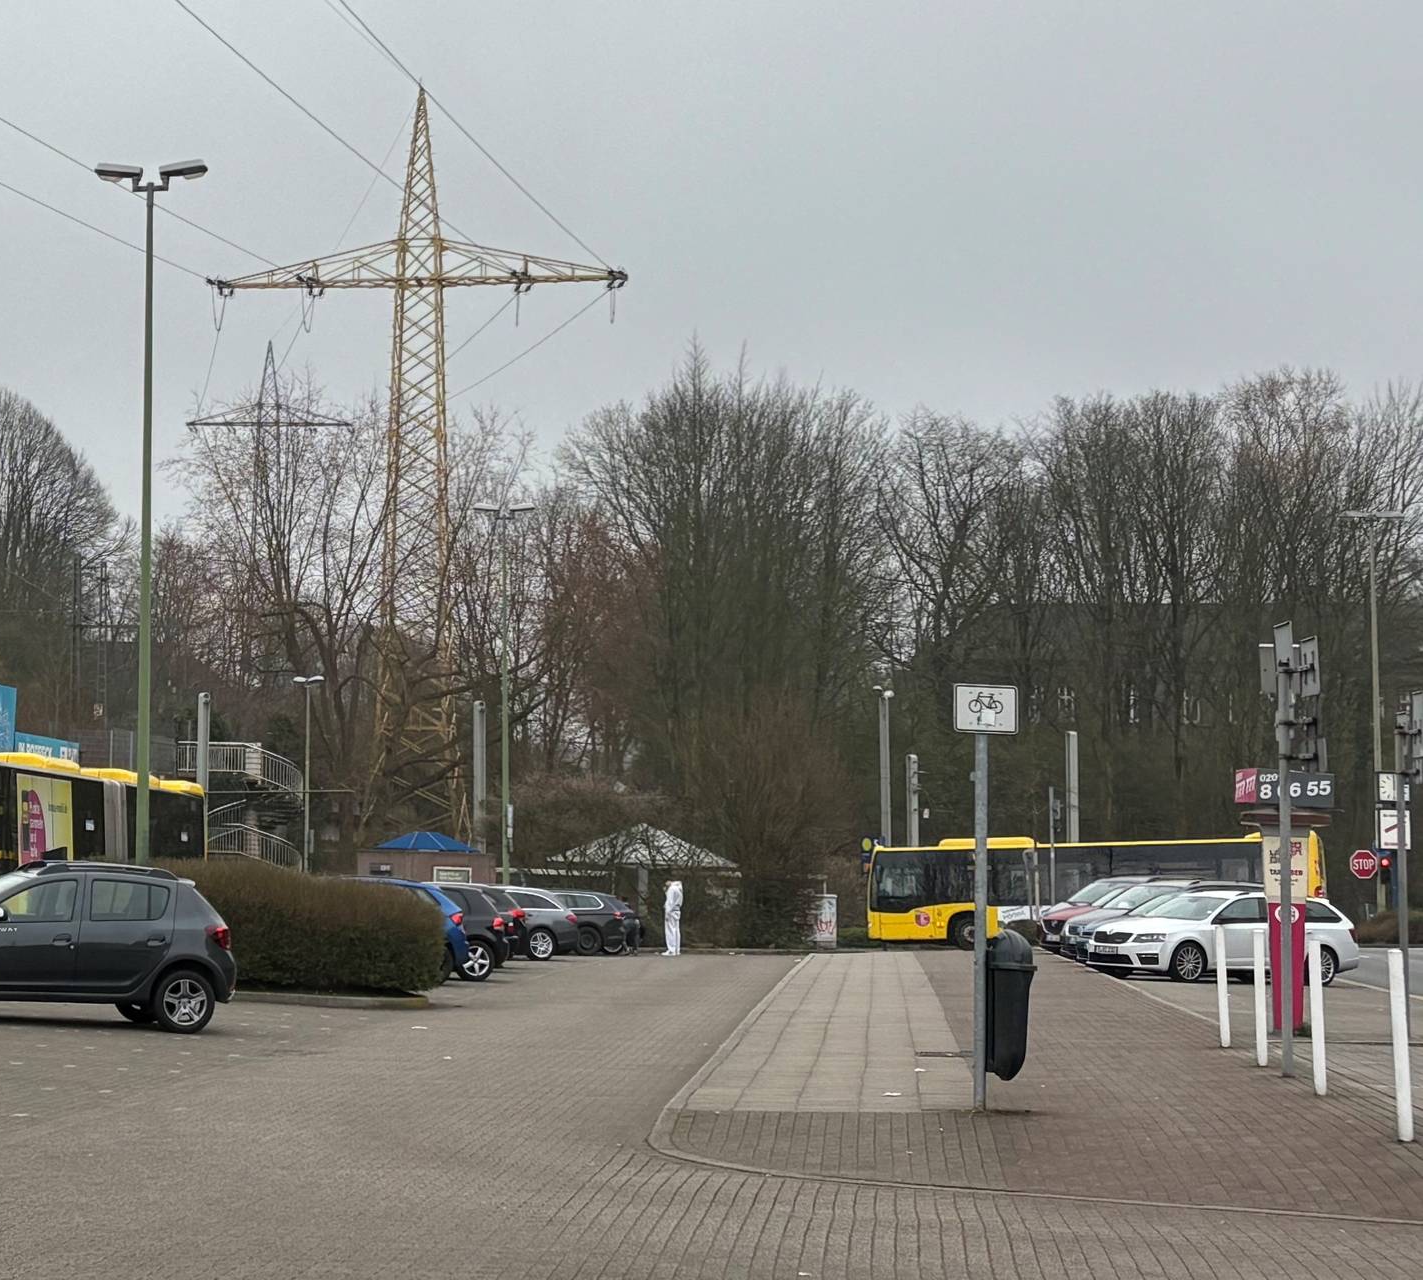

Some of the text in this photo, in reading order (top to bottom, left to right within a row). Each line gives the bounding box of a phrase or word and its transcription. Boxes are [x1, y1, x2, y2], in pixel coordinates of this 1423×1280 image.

[1259, 783, 1272, 799] 8
[1306, 780, 1331, 796] 55
[1353, 858, 1375, 870] STOP
